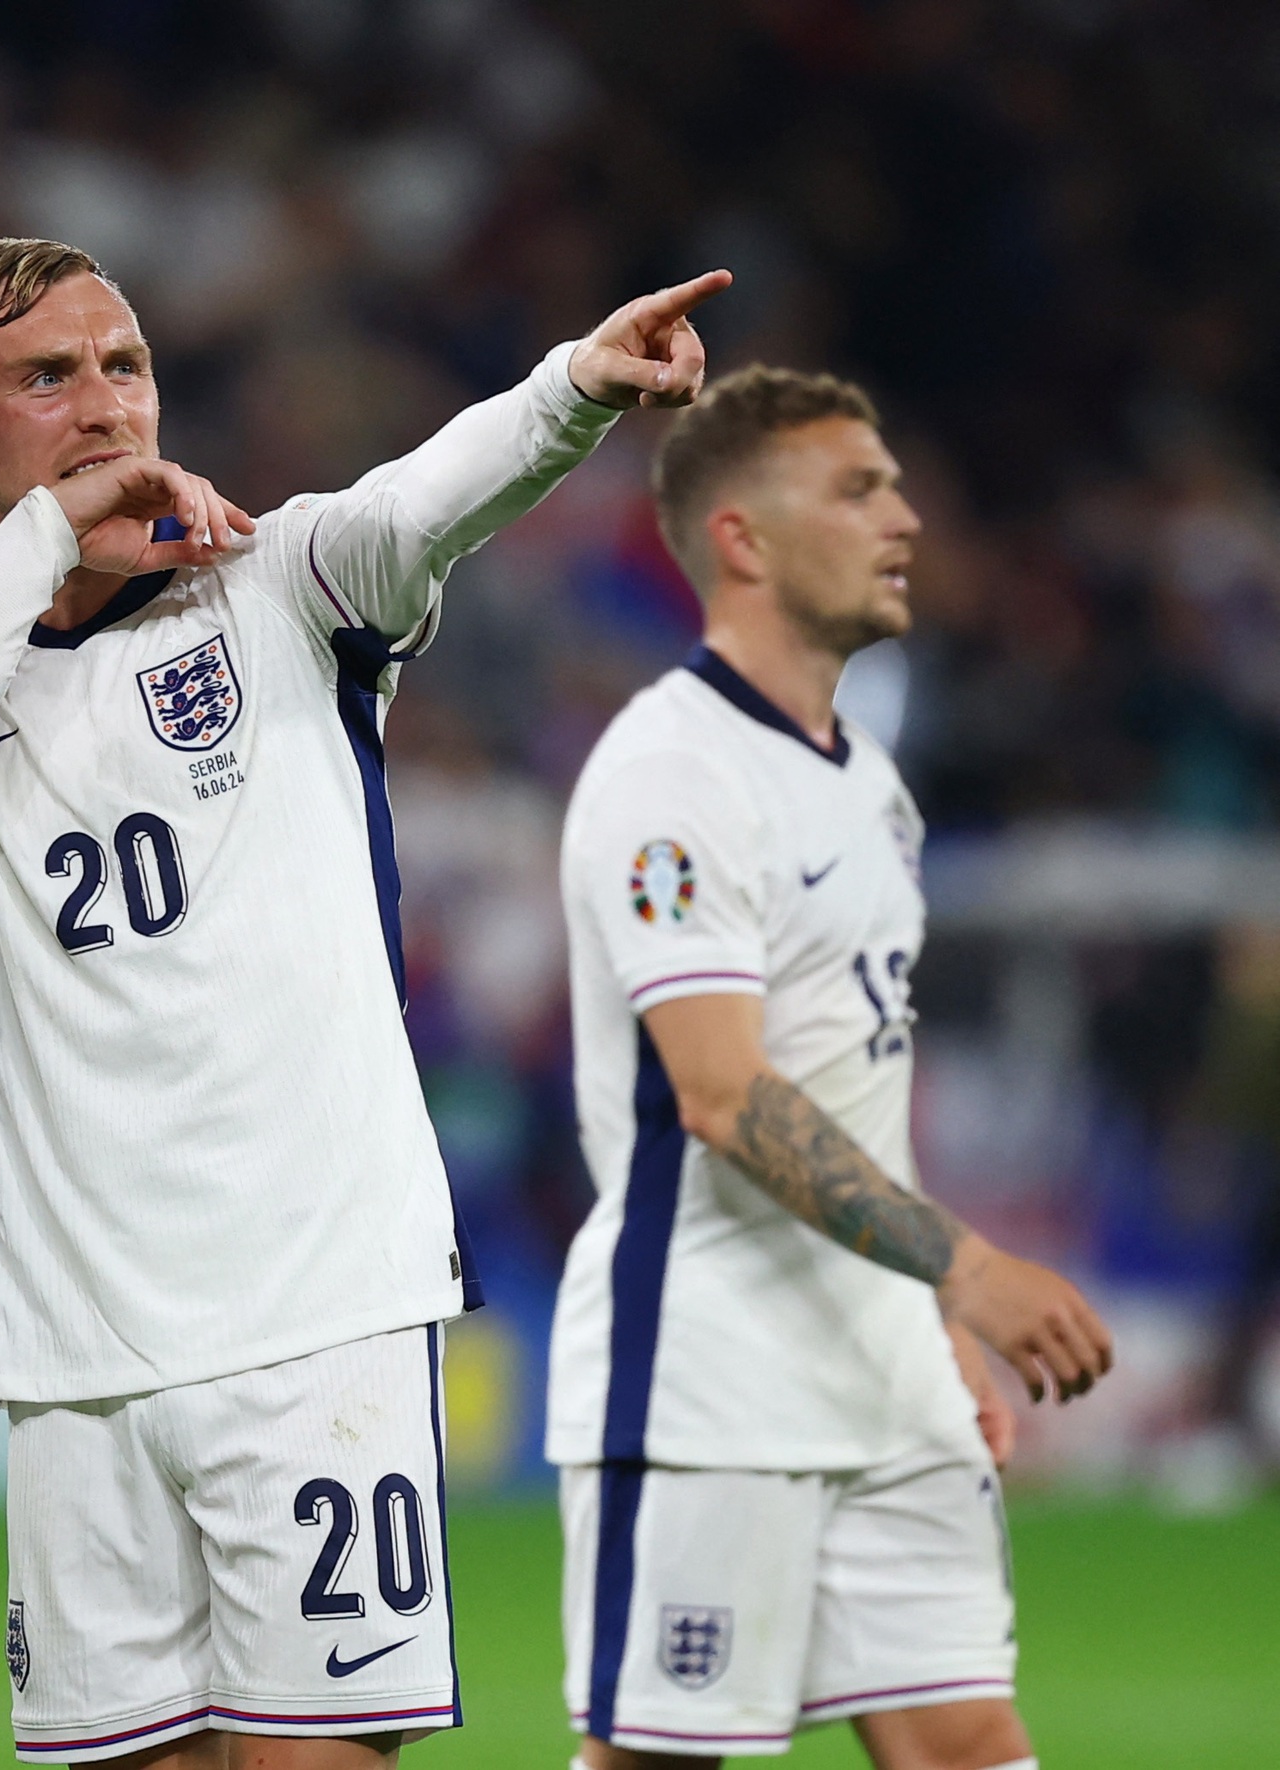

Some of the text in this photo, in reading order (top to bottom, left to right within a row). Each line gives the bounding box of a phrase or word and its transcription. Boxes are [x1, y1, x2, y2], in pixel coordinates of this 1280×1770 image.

[188, 750, 238, 779] SERBIA
[193, 769, 245, 801] 16.06.24
[44, 812, 189, 956] 20
[293, 1472, 433, 1621] 20
